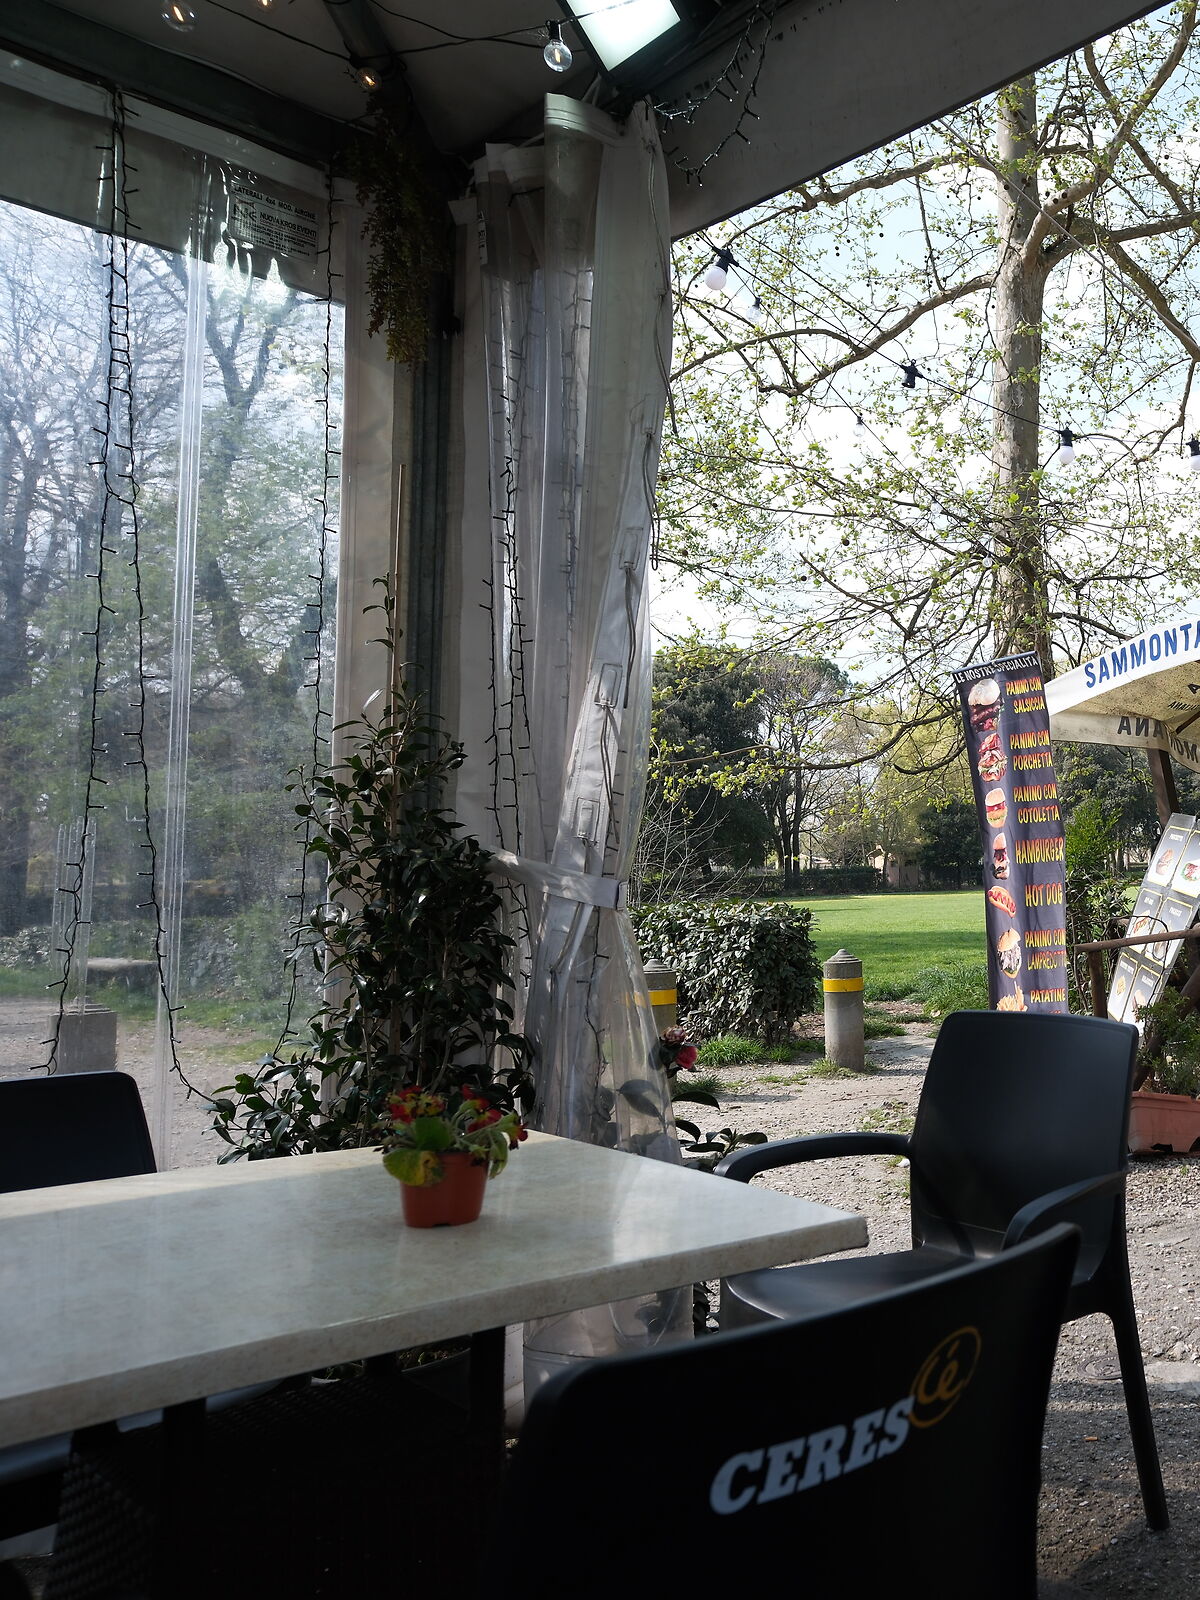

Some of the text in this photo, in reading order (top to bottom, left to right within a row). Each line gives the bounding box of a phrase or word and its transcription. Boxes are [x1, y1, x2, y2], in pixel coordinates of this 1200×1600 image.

[954, 673, 965, 684] LE
[965, 665, 995, 681] NOSTRE
[1005, 677, 1043, 696] PANINO CON
[1013, 696, 1046, 714] SALSICCIA
[1009, 729, 1050, 750] PANINO CON
[1013, 752, 1053, 771] PORCHETTA
[1013, 783, 1058, 803] PANINO CON
[1018, 805, 1060, 824] COTOLETTA
[1015, 837, 1064, 865] HAMBURGER
[1025, 881, 1063, 907] HOT DOG
[1024, 929, 1052, 948] PANINO
[1030, 988, 1066, 1004] PATATINE
[709, 1394, 915, 1515] CERES
